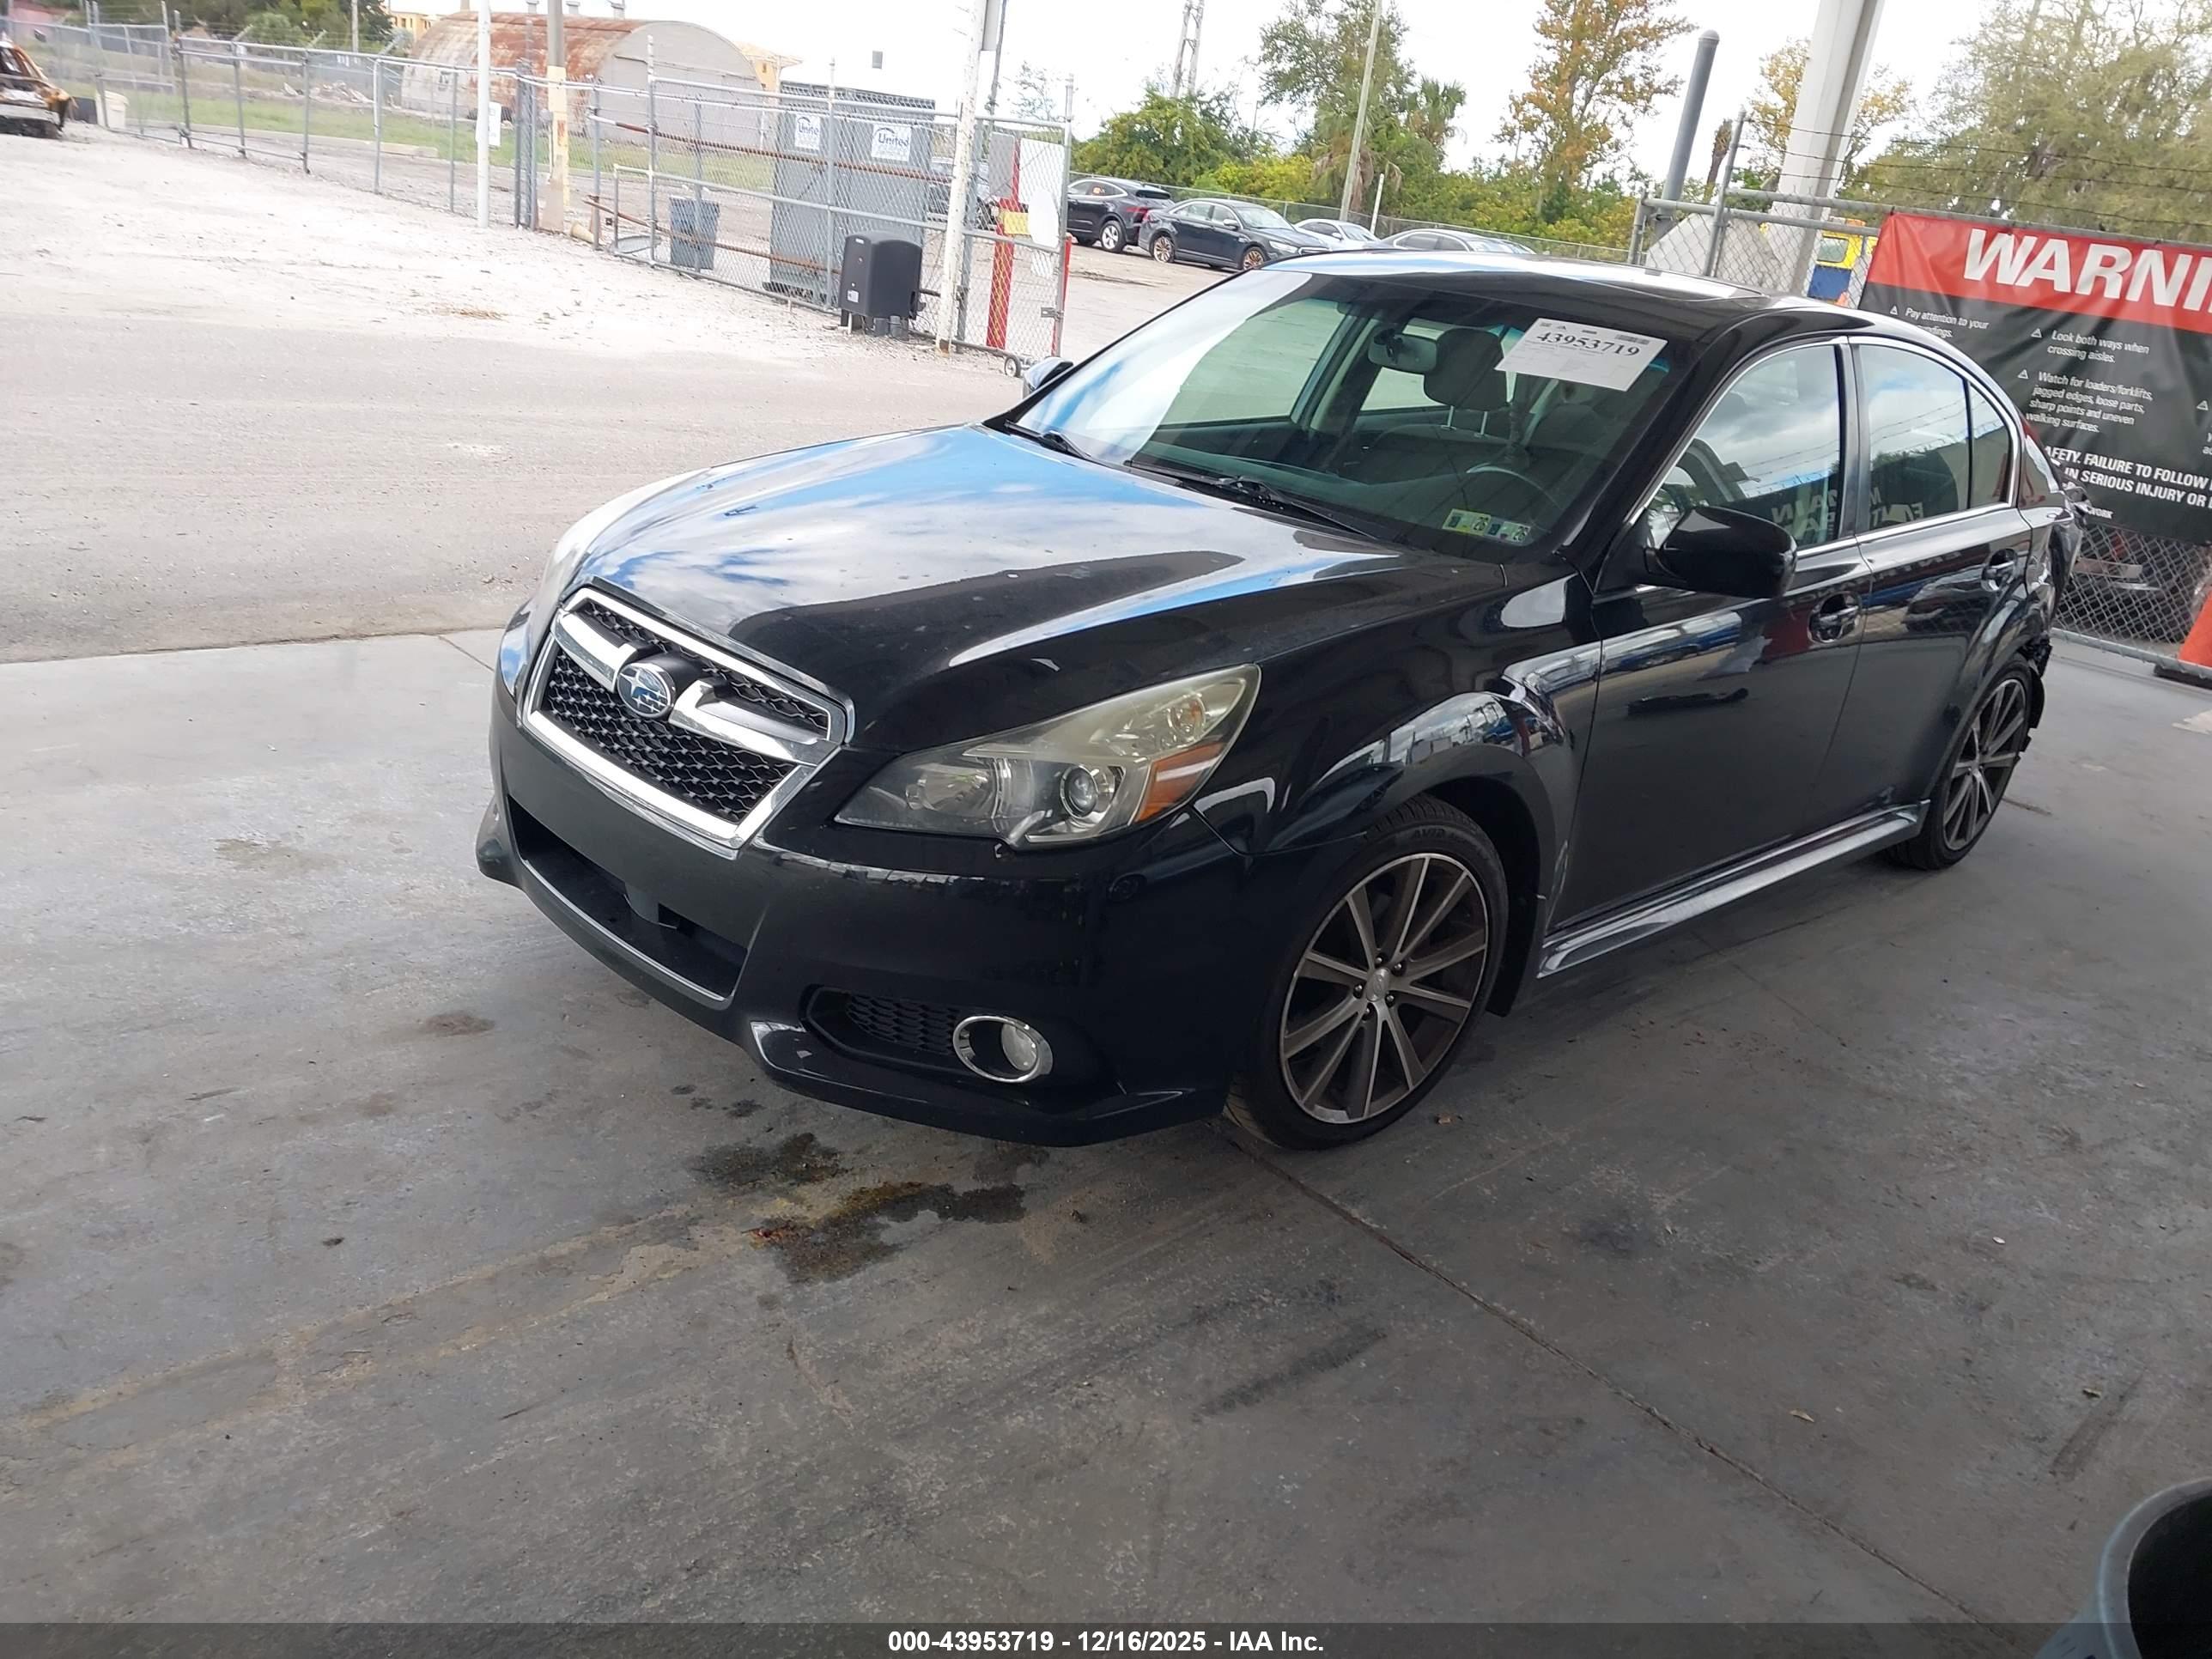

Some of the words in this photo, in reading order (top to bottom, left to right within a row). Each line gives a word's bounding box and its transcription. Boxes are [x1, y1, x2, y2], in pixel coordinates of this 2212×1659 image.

[1964, 228, 2212, 314] WARNI
[1905, 307, 1922, 320] Pay
[1921, 312, 1957, 325] attention
[1958, 317, 1968, 326] to
[1968, 319, 1990, 330] your
[1536, 331, 1641, 357] 43953719
[2047, 344, 2087, 361] crossing
[2087, 349, 2116, 364] aisles.
[2051, 330, 2074, 343] Look
[2075, 333, 2097, 346] both
[2099, 338, 2123, 352] ways
[2124, 342, 2150, 355] when
[2038, 370, 2069, 386] Watch
[2069, 376, 2085, 388] for
[2032, 385, 2065, 399] jagged
[2095, 395, 2119, 409] loose
[2026, 412, 2061, 428] walking
[2061, 419, 2100, 433] surfaces.
[2029, 398, 2057, 412] sharp
[2056, 403, 2086, 416] points
[2086, 408, 2103, 419] and
[2101, 411, 2136, 426] uneven
[2045, 445, 2081, 465] AFETY.
[2082, 452, 2133, 474] FAILURE
[2135, 463, 2153, 478] TO
[2153, 467, 2209, 490] FOLLOW
[2080, 470, 2134, 493] SERIOUS
[2135, 481, 2187, 504] INJURY
[2186, 493, 2207, 508] OR
